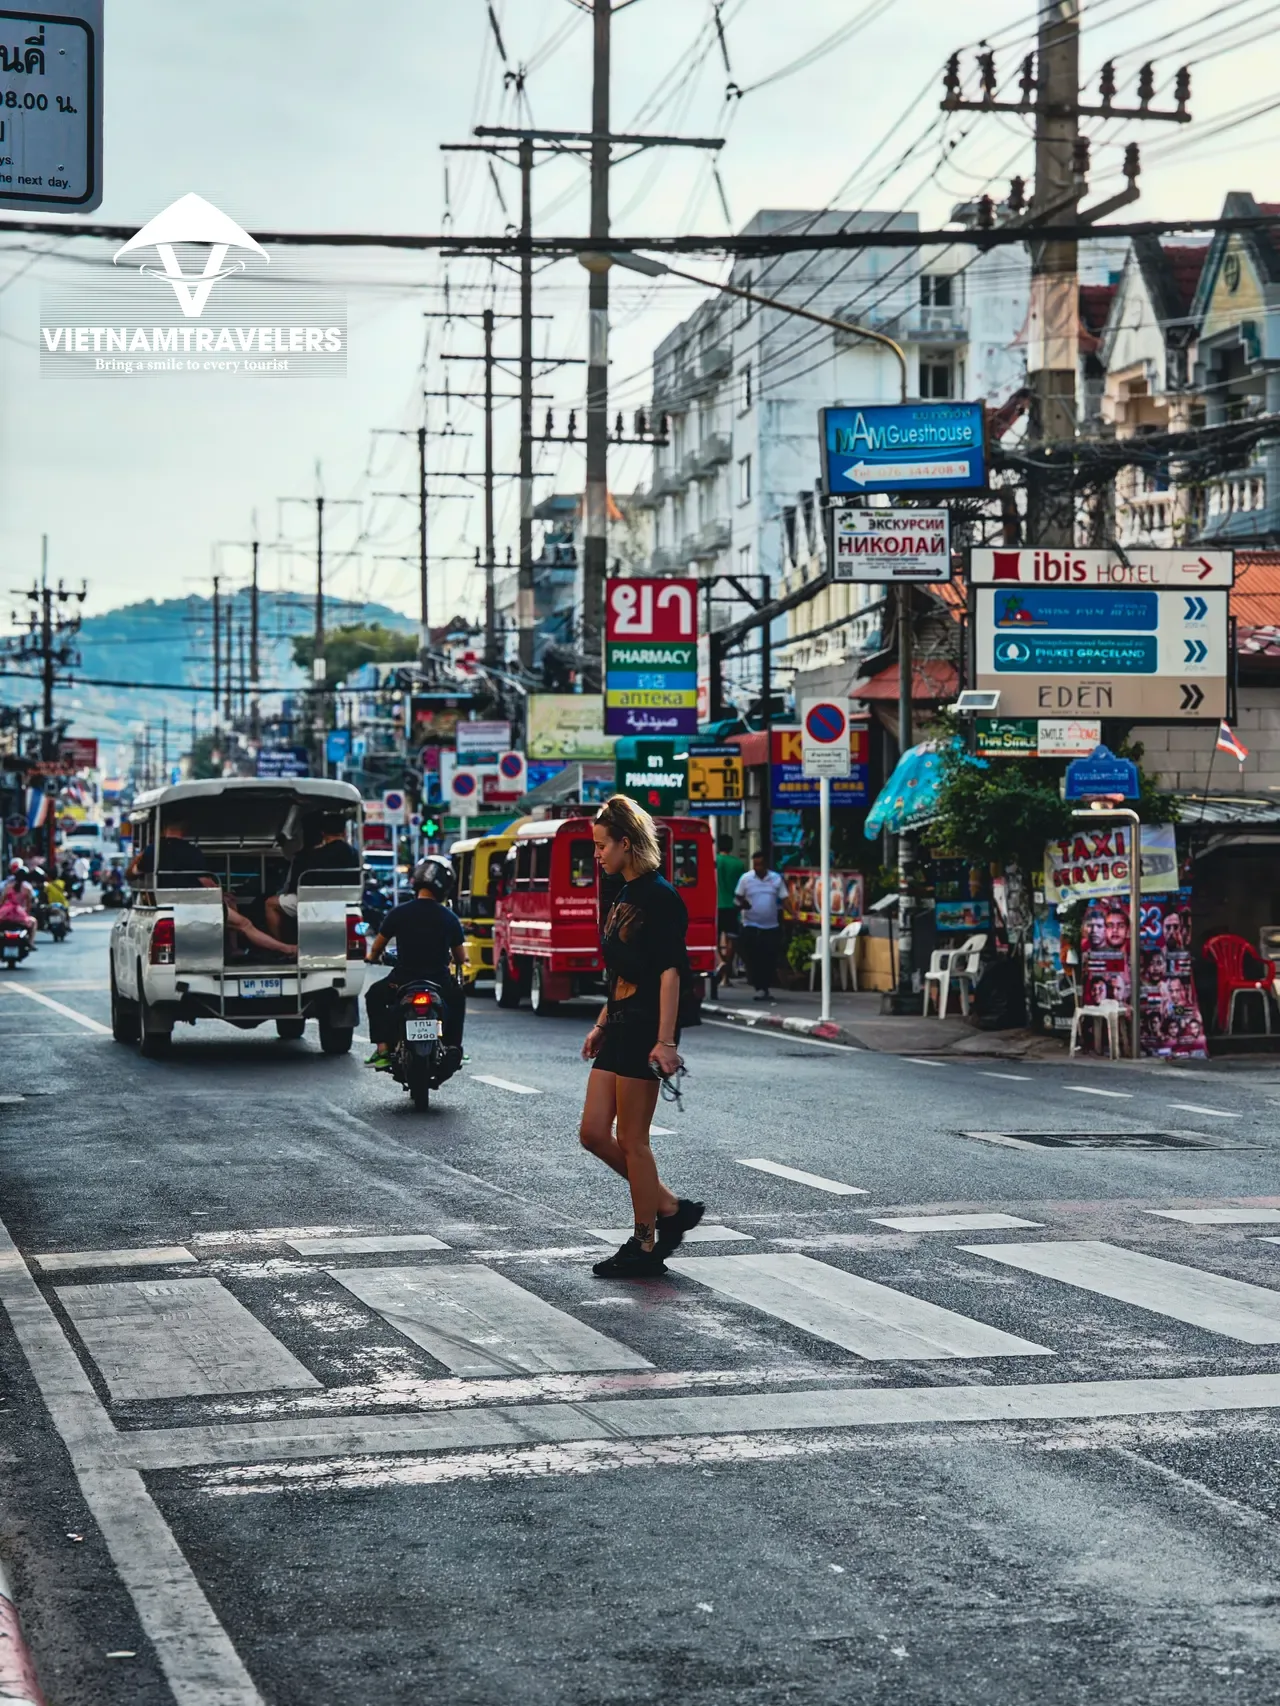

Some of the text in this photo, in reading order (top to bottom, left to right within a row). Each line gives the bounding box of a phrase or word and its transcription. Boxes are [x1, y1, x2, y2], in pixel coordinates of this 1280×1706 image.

[18, 175, 42, 186] next
[48, 176, 71, 189] day.
[868, 518, 945, 530] ЭКСКУРСИИ
[838, 533, 945, 553] НИКОЛАЙ
[1033, 552, 1160, 583] ibis HOTEL
[611, 584, 692, 634] ยา
[612, 650, 690, 664] PHARMACY
[1035, 648, 1145, 658] PHUKET GRACELAND
[1038, 686, 1113, 709] EDEN
[626, 709, 679, 732] صيدلية
[625, 773, 684, 787] PHARMACY
[1058, 832, 1125, 863] TAXI
[1053, 861, 1144, 887] SERVIC
[260, 979, 280, 988] 1859
